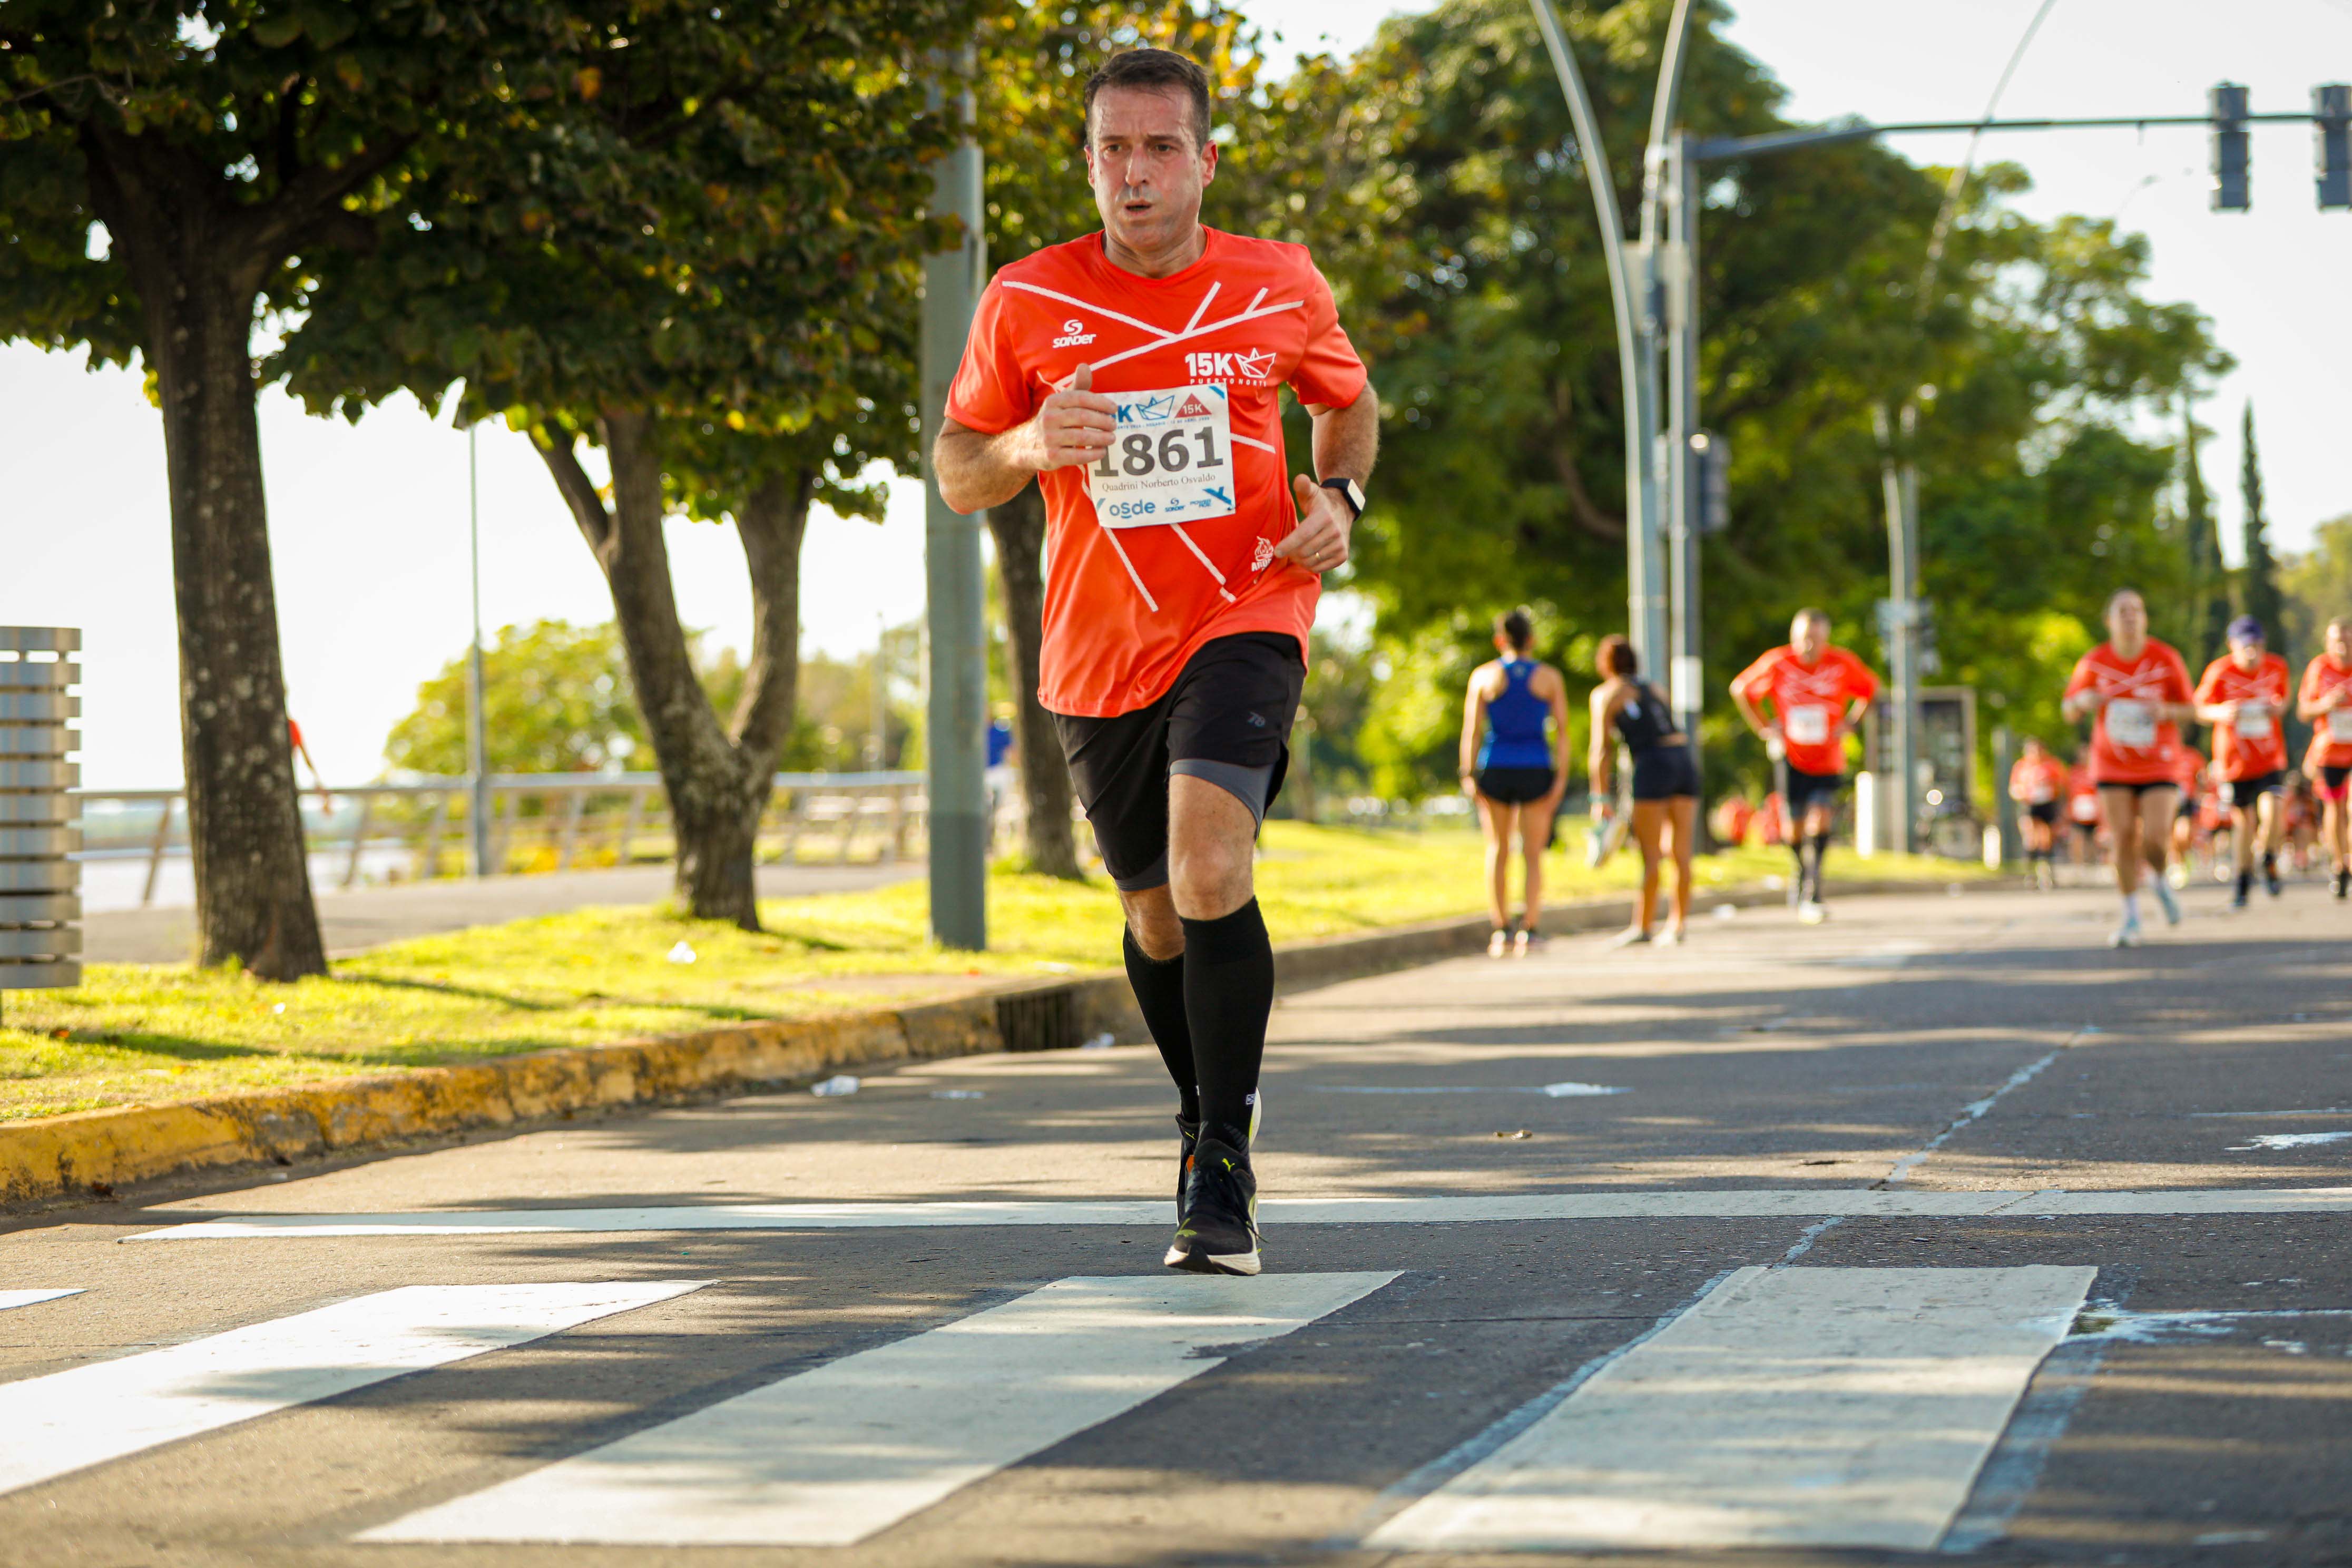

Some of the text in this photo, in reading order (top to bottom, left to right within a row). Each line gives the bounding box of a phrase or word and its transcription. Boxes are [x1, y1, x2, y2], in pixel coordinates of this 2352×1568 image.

[1185, 352, 1235, 377] 15K
[1183, 404, 1202, 414] 15K
[1102, 473, 1216, 492] Quadrini Norberto Osvaldo
[1109, 499, 1155, 518] osde
